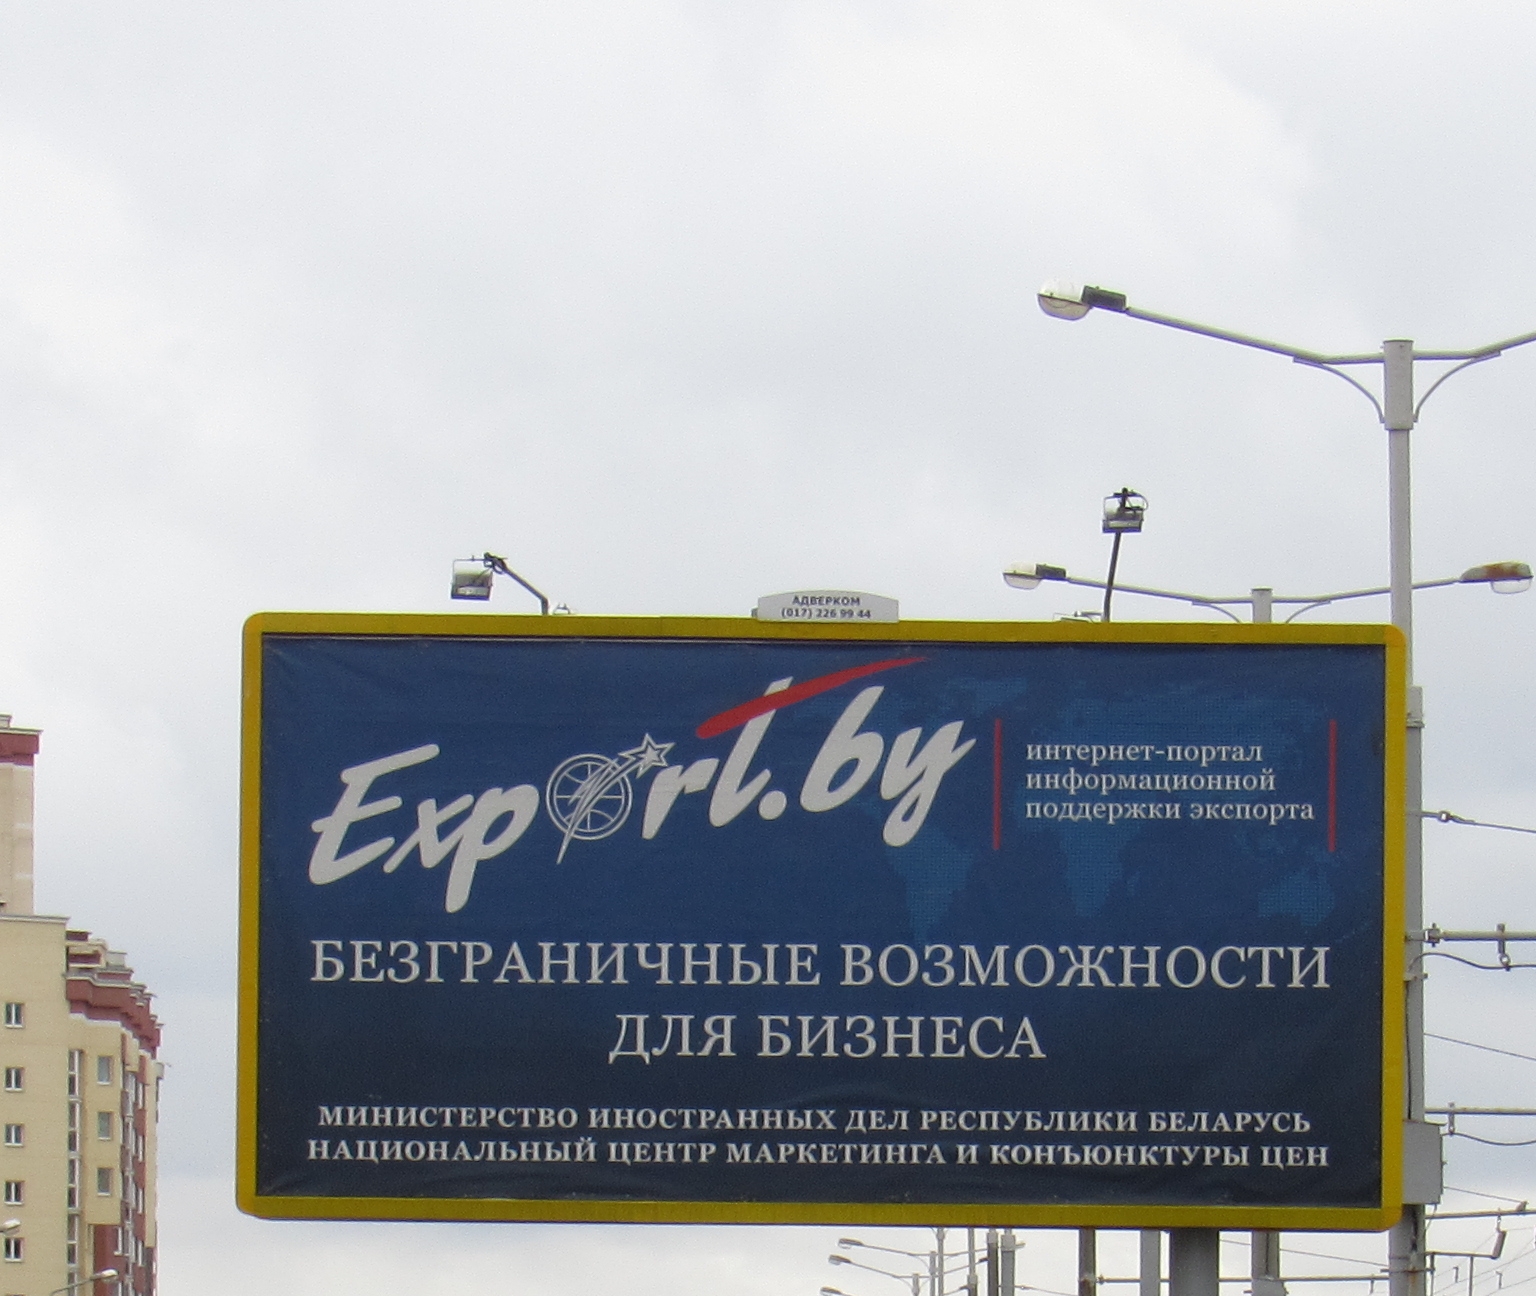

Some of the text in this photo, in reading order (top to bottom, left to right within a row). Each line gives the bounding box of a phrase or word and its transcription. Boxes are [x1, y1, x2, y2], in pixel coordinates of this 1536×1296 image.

[781, 608, 872, 619] (017) 226 99 44
[792, 595, 861, 606] АДВЕРКОМ
[1025, 744, 1263, 767] интернет-портал
[1025, 767, 1276, 796] информационной
[1025, 801, 1315, 826] поддержки экспорта
[309, 939, 1331, 989] БЕЗГРАНИЧНЫЕ ВОЗМОЖНОСТИ
[607, 1014, 1048, 1065] ДЛЯ БИЗНЕСА
[318, 1105, 1311, 1134] МИНИСТЕРСТВО ИНОСТРАННЫХ ДЕЛ РЕСПУБЛИКИ БЕЛАРУСЬ
[307, 1136, 1329, 1170] НАЦИОНАЛЬНЫЙ ЦЕНТР МАРКЕТИНГА И КОНЪЮНКТУРЫ ЦЕН
